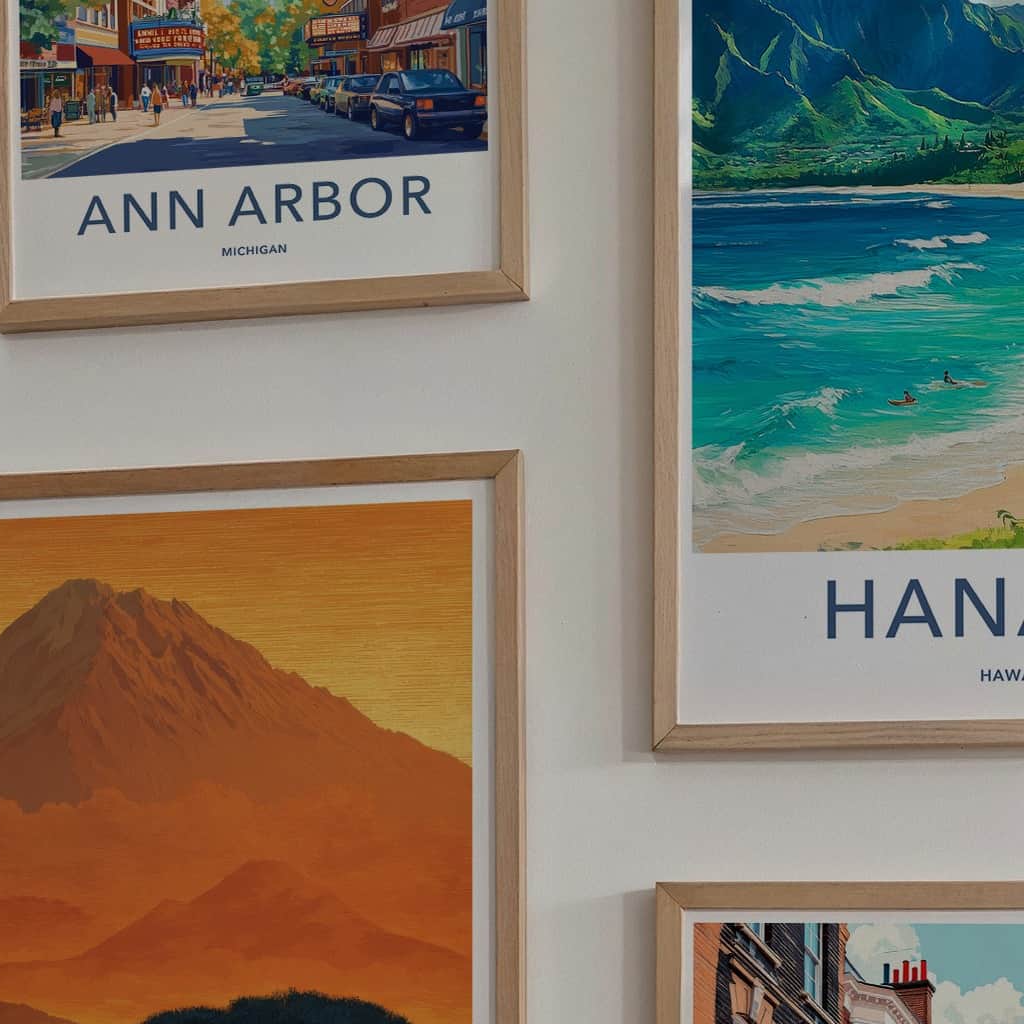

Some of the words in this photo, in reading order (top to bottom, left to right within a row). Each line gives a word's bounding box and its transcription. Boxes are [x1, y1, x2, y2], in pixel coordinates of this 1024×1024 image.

[78, 188, 205, 237] ANN
[228, 175, 433, 226] ARBOR
[221, 243, 288, 257] MICHIGAN
[826, 577, 1024, 640] HAN
[980, 669, 1024, 682] HAW
